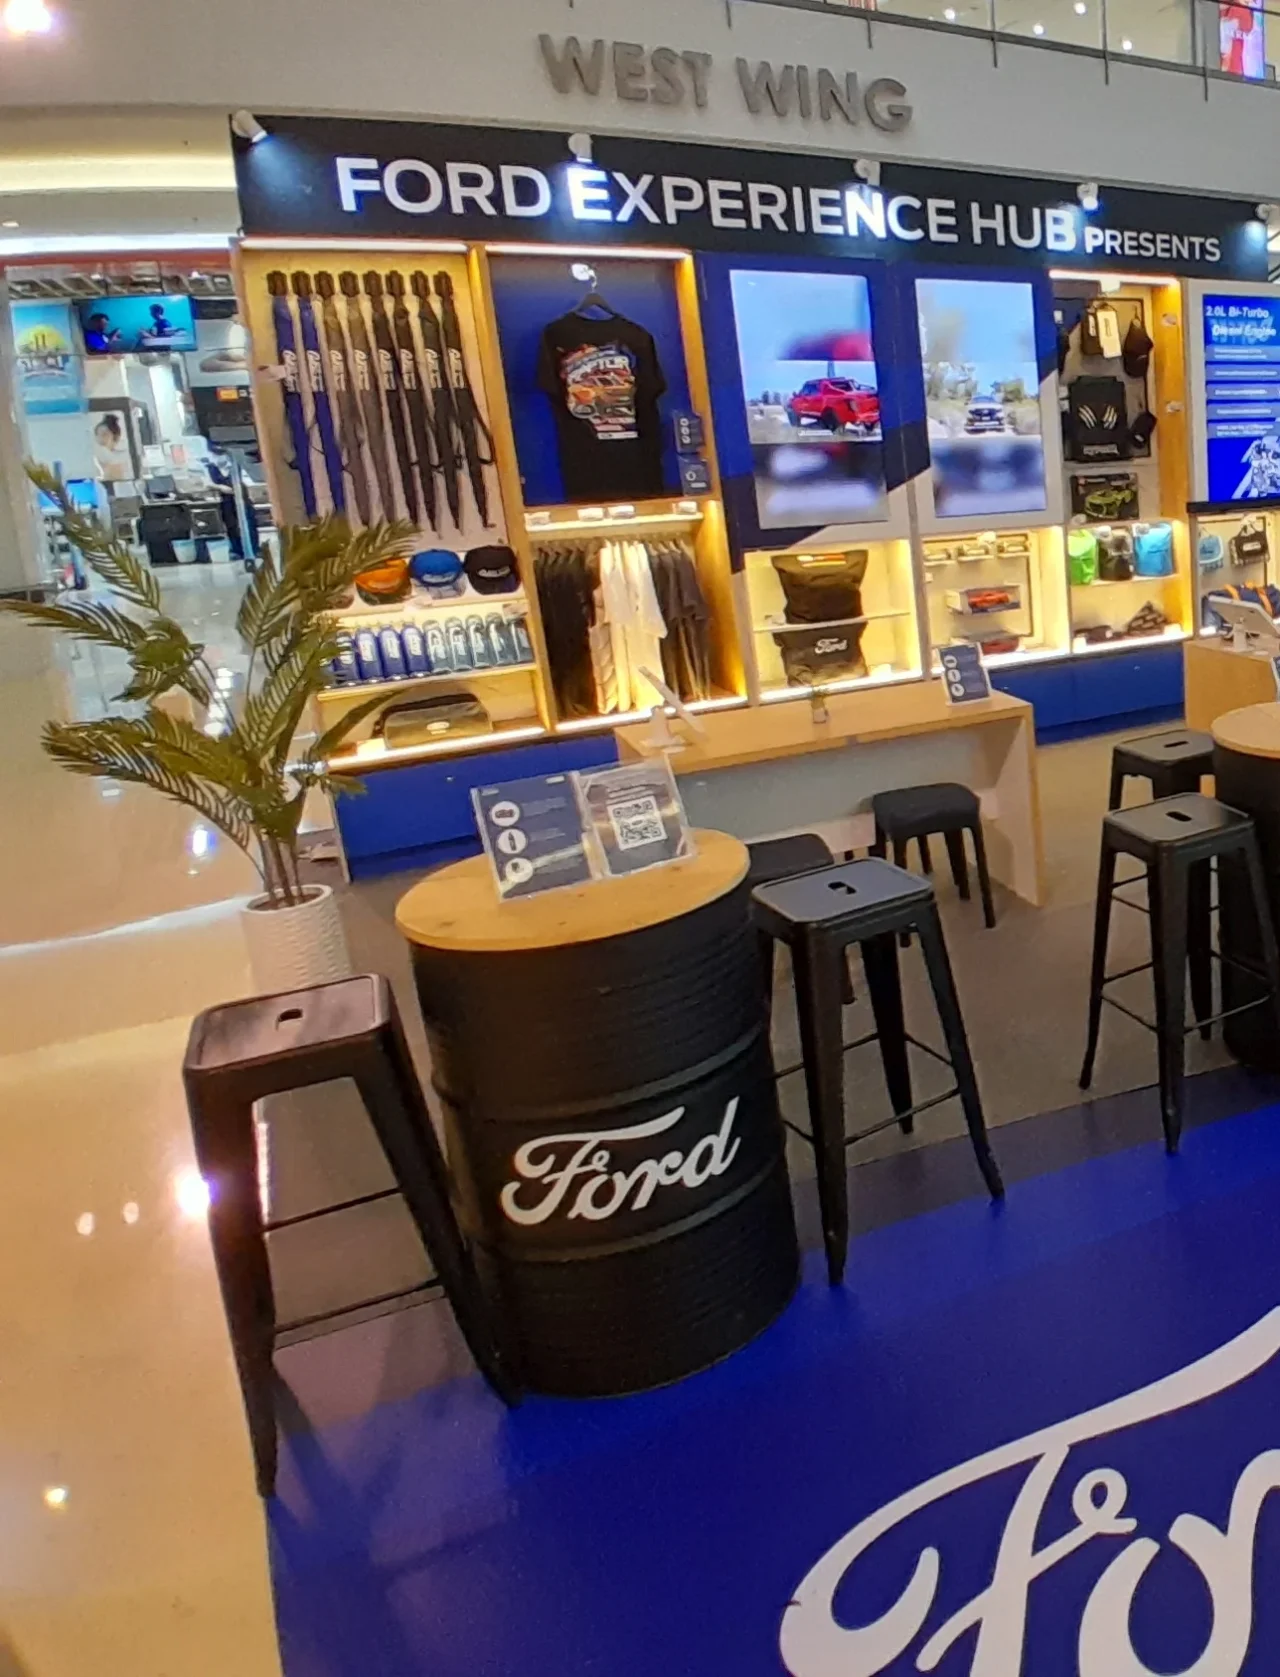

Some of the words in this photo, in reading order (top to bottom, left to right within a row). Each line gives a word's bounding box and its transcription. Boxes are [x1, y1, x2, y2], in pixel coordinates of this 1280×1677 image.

[538, 34, 712, 108] WEST
[735, 57, 913, 132] WING
[335, 157, 551, 217] FORD
[566, 166, 959, 243] EXPERIENCE
[971, 201, 1077, 252] HUB
[1085, 227, 1221, 262] PRESENTS
[1206, 305, 1227, 317] 2.0L
[1228, 306, 1270, 319] Bi-Turbo
[815, 638, 848, 655] Ford
[501, 1096, 741, 1226] Ford
